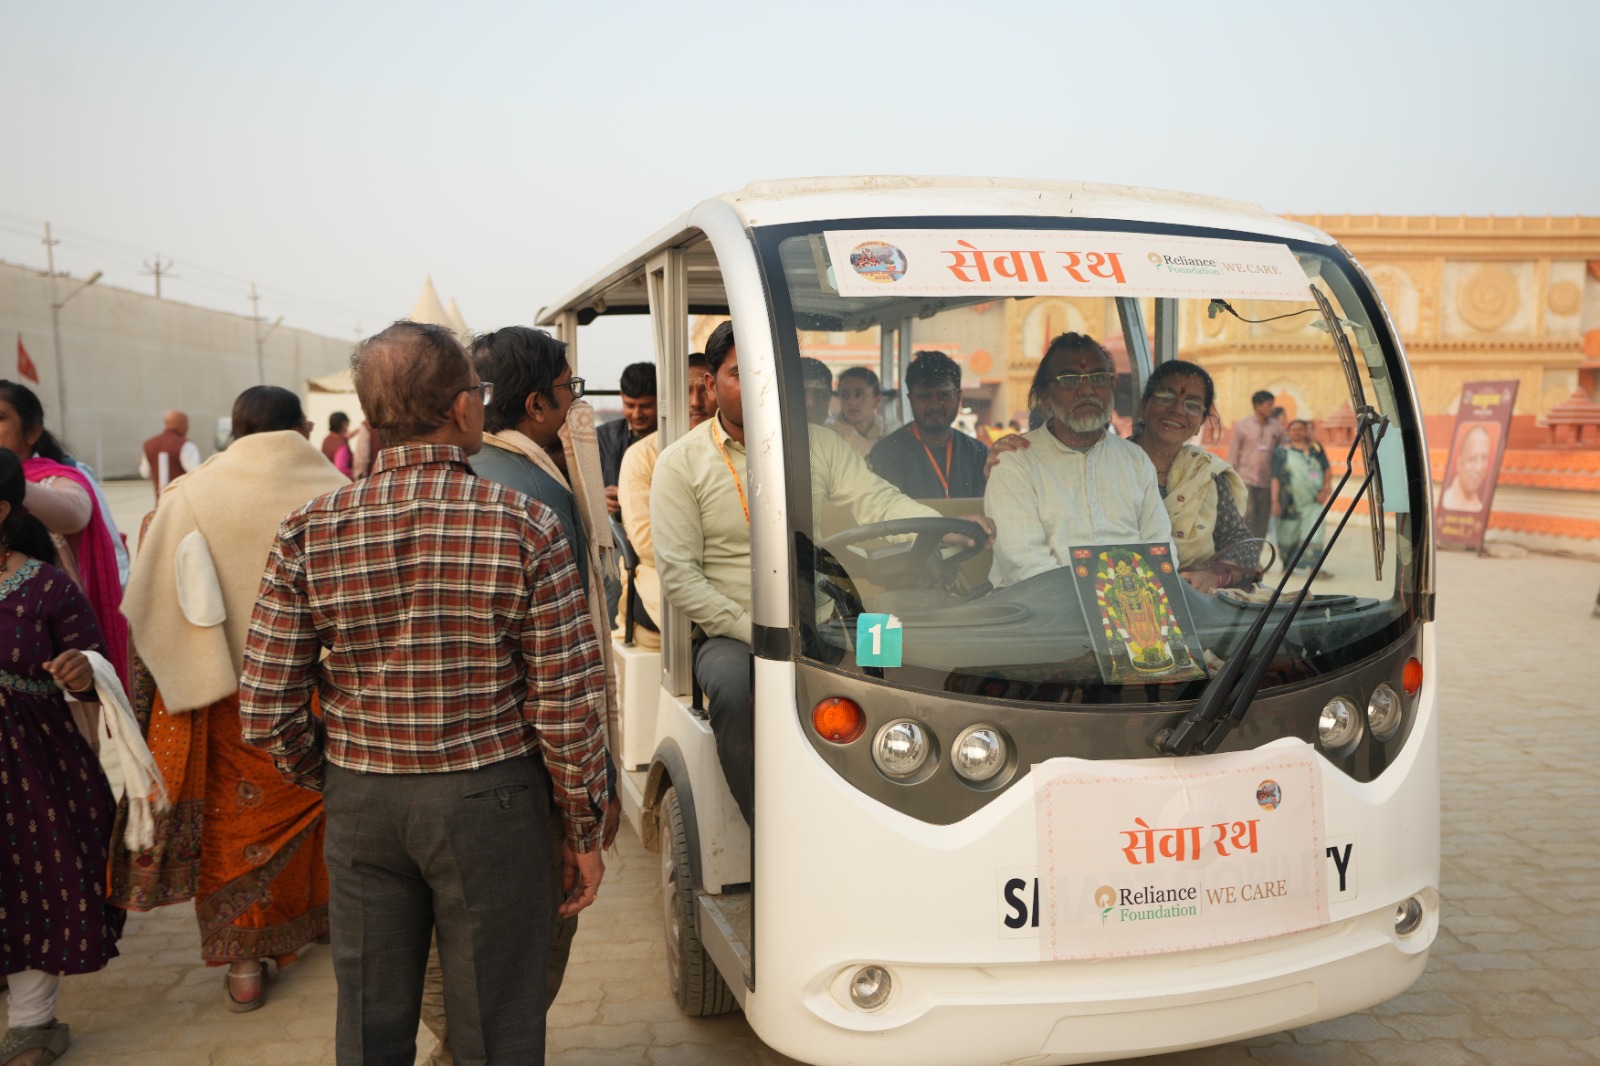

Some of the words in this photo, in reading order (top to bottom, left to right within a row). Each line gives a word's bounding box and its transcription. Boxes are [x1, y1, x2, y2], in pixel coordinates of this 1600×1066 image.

[940, 240, 1048, 282] सेवा
[1055, 251, 1126, 283] रथ
[1163, 254, 1216, 267] Reliance
[1167, 265, 1220, 275] Foundation
[1222, 262, 1246, 273] WE
[1246, 264, 1282, 274] CARE
[868, 623, 881, 655] 1
[1119, 817, 1204, 865] सेवा
[1211, 819, 1260, 856] रथ
[1119, 886, 1197, 906] Reliance
[1206, 886, 1237, 905] WE
[1241, 879, 1288, 902] CARE
[1120, 903, 1197, 922] Foundation
